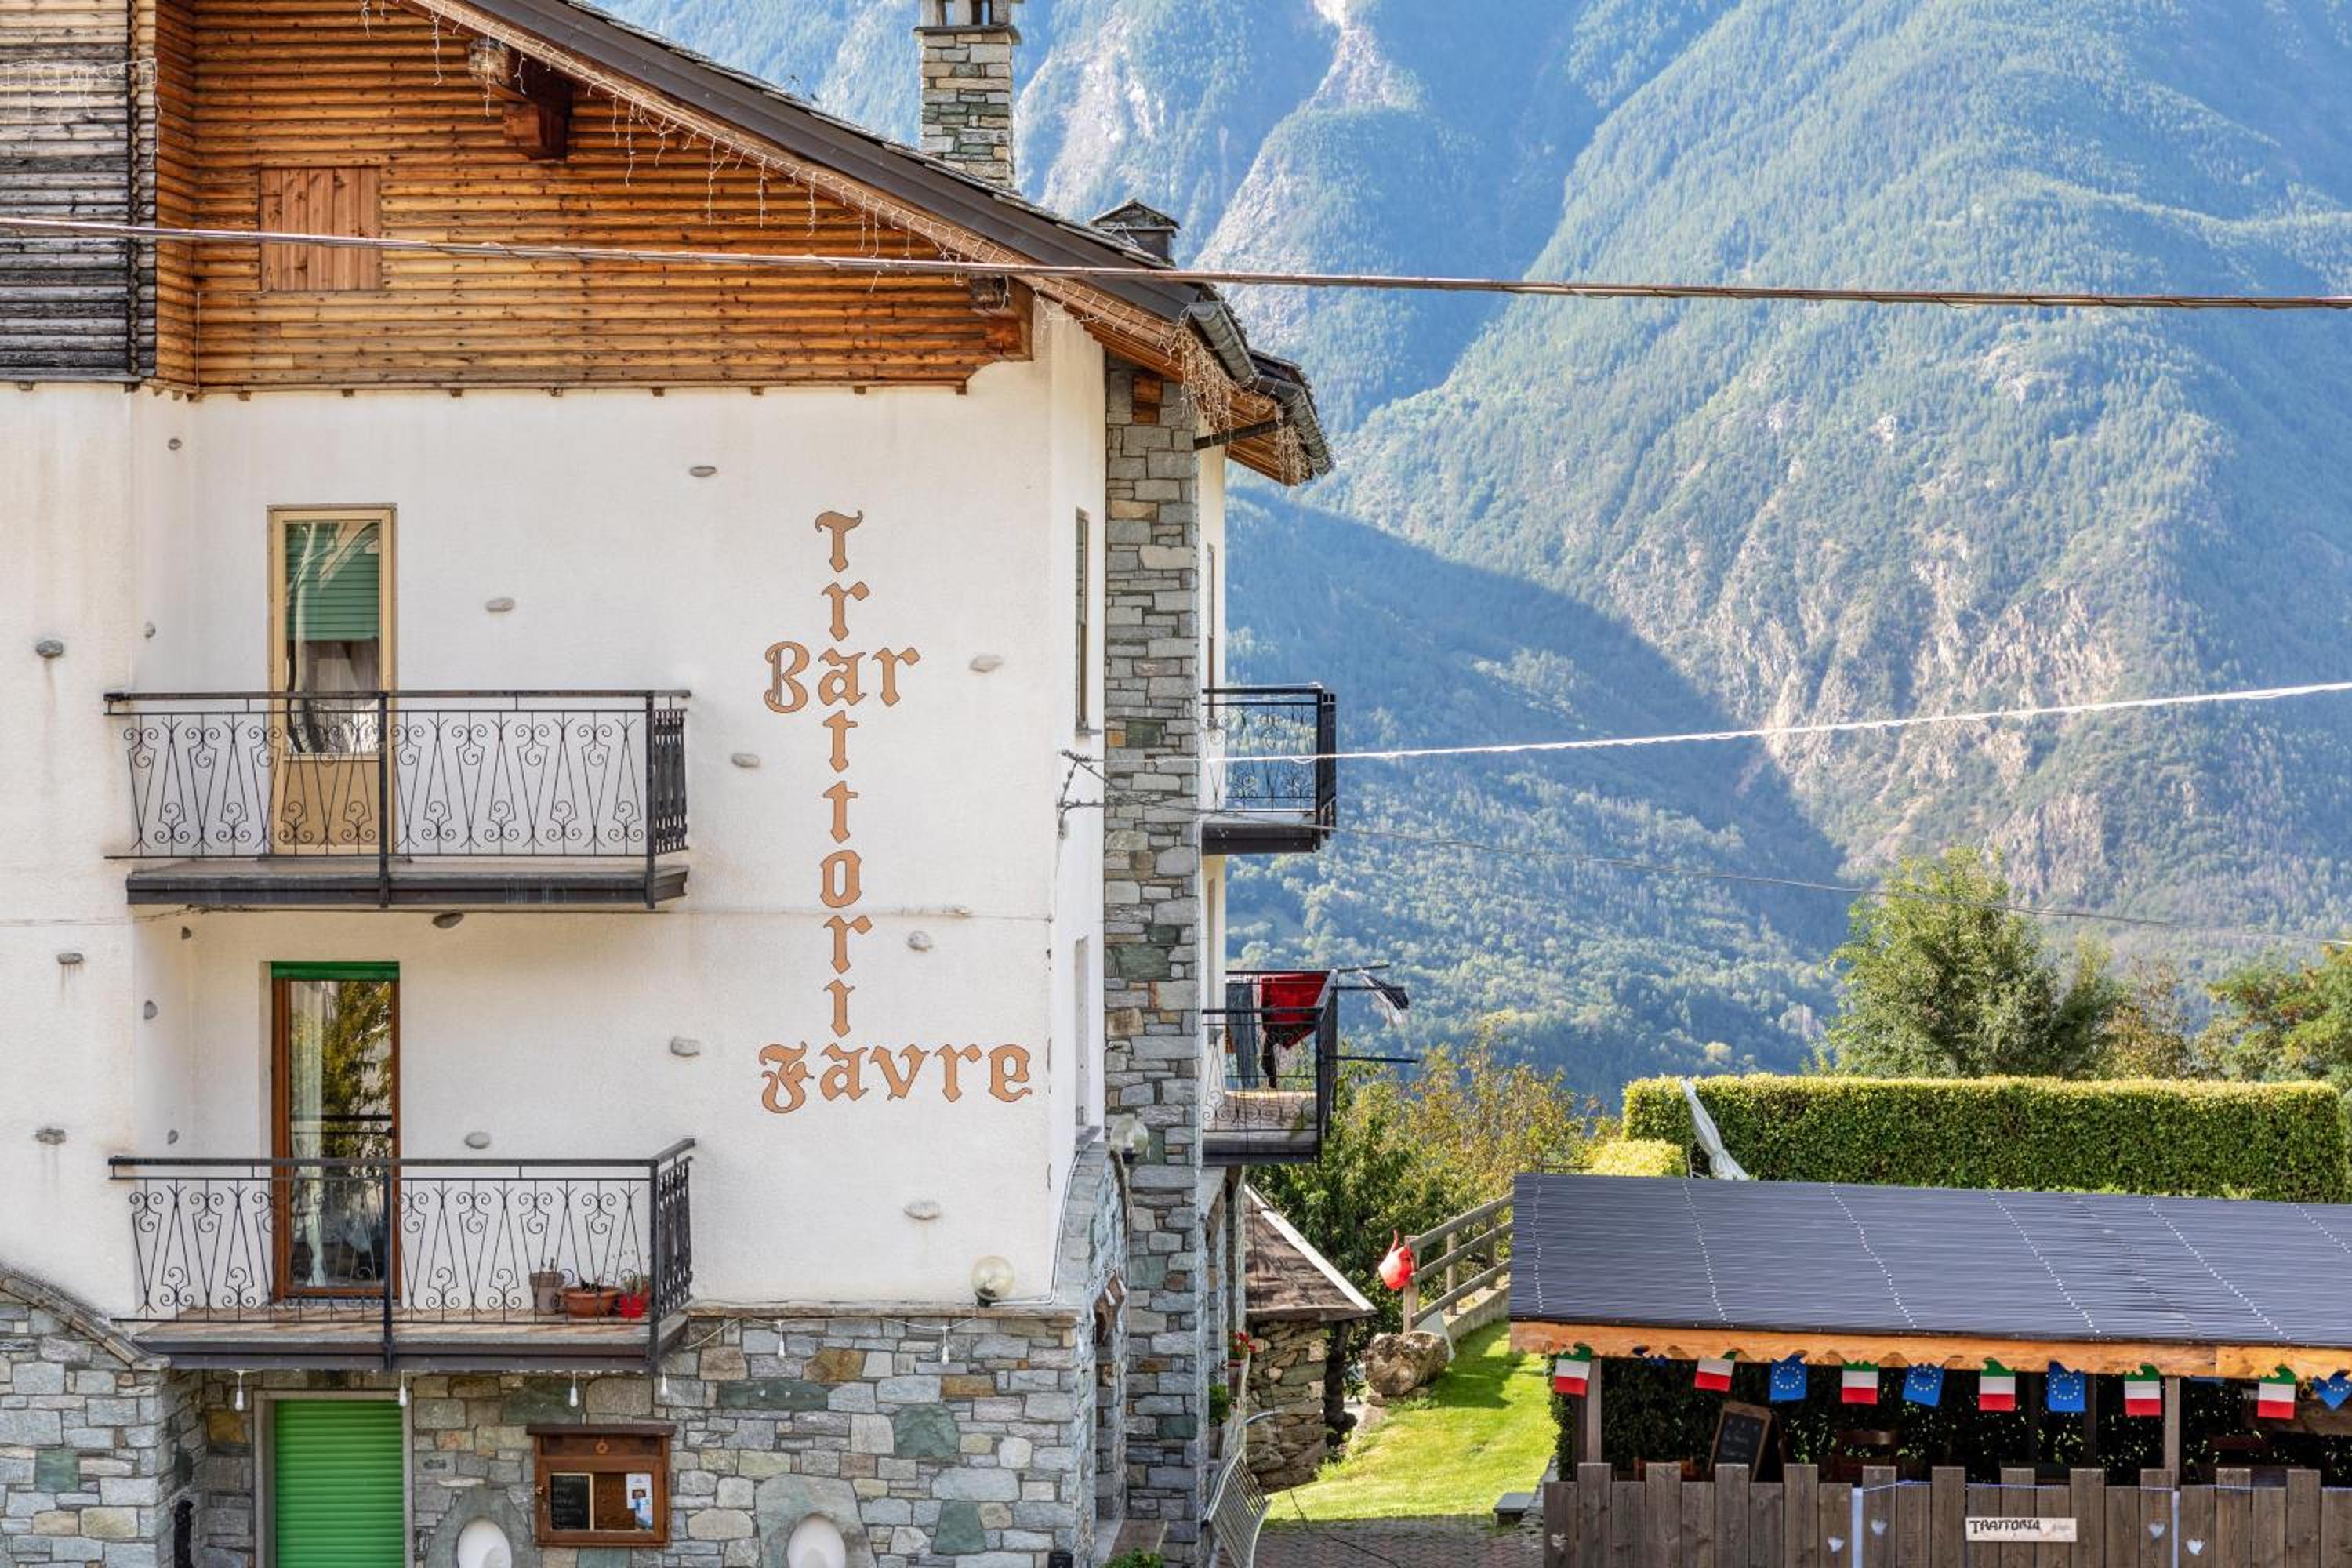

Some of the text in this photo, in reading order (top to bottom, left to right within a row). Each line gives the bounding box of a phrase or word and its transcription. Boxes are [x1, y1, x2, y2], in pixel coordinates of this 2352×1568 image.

[764, 641, 920, 713] Bar
[759, 1041, 1033, 1114] Favre
[1969, 1519, 2042, 1534] TRATTORIA
